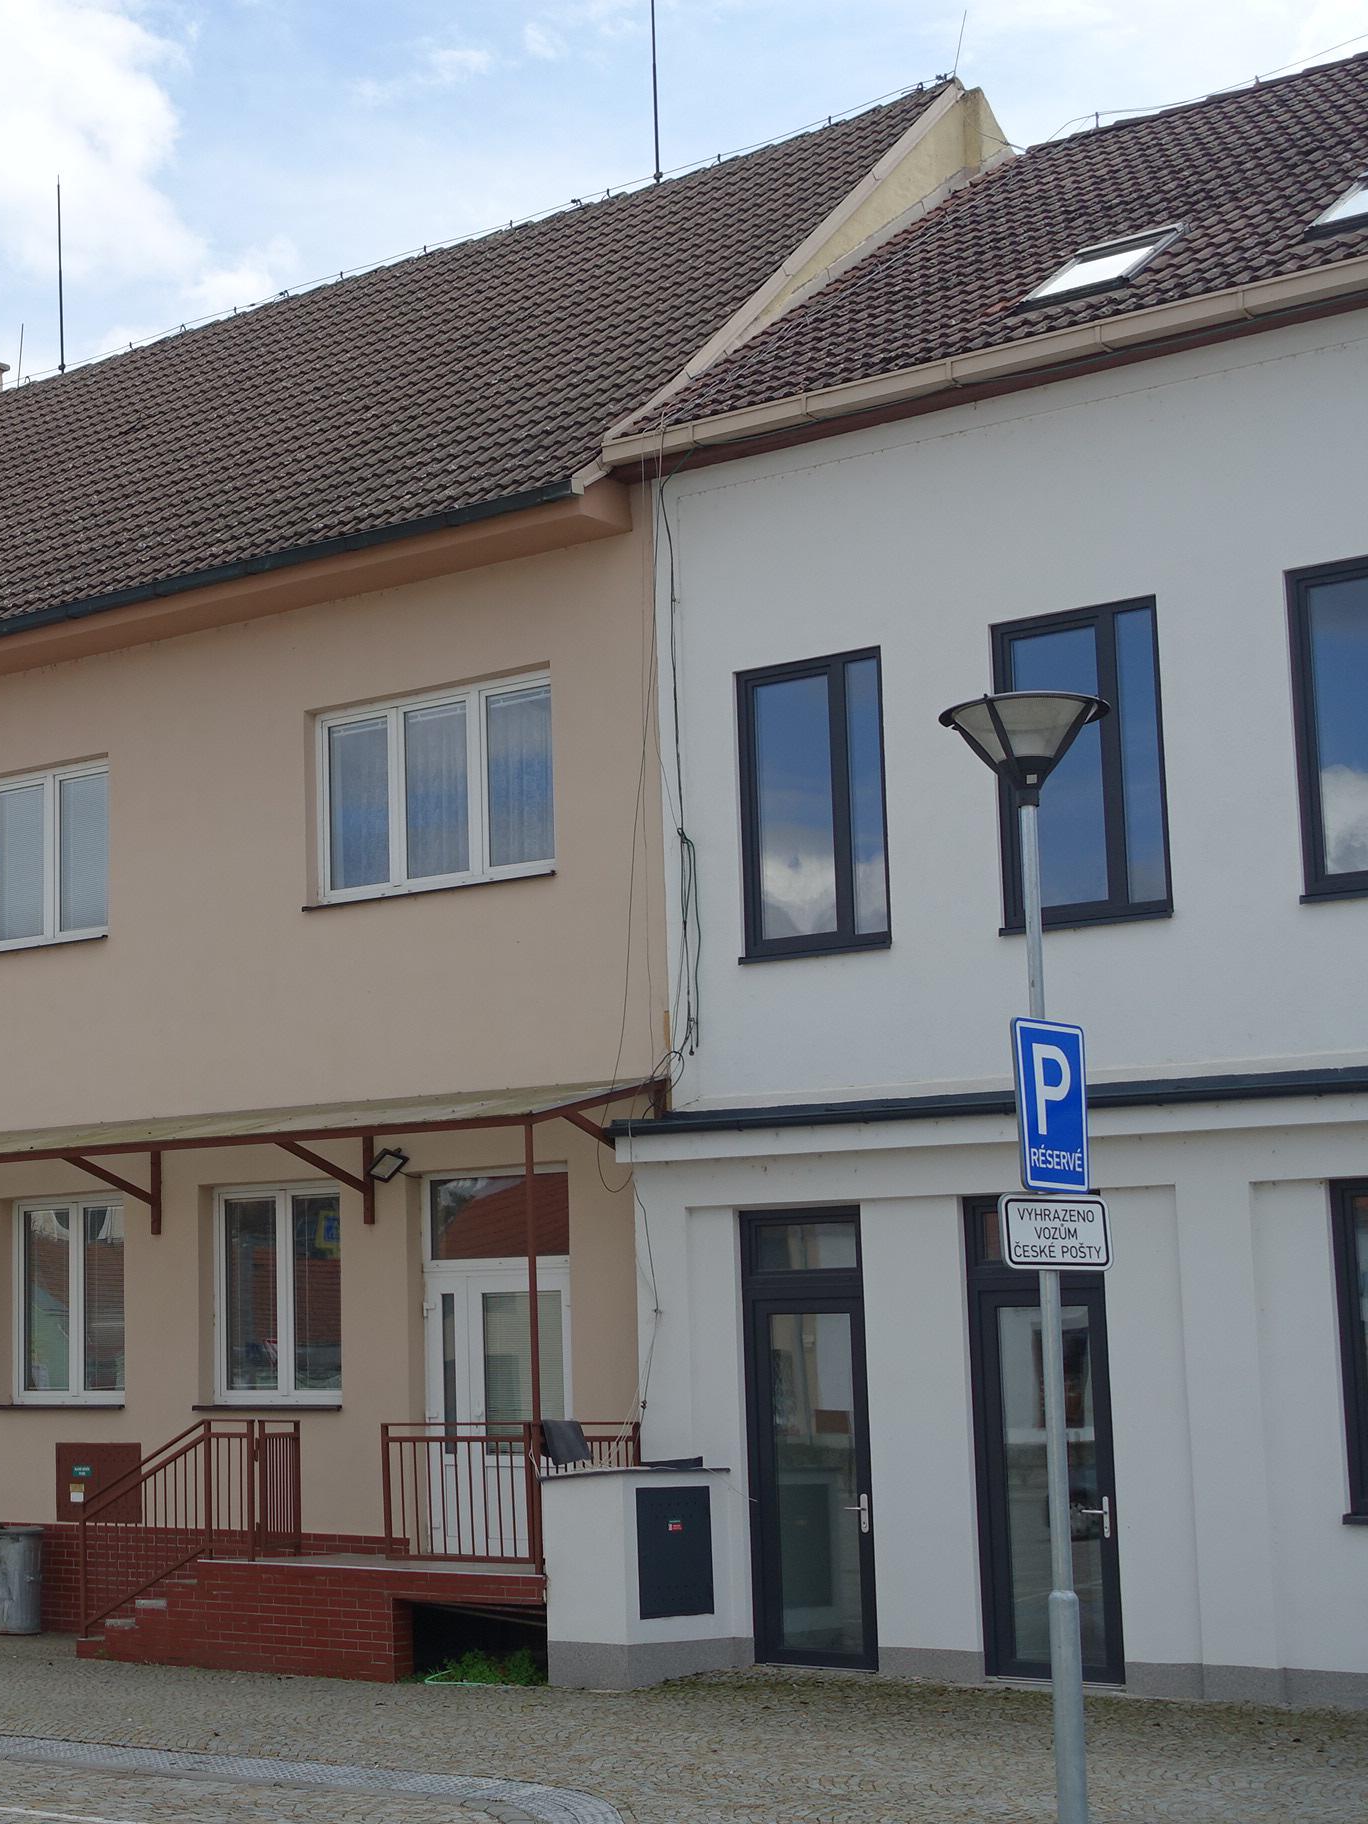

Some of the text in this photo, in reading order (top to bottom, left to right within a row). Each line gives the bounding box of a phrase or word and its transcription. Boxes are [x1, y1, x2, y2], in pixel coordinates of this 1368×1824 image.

[1032, 1042, 1071, 1135] P
[1031, 1144, 1083, 1172] RÉSERVÉ
[1017, 1208, 1095, 1223] VYHRAZENO
[1034, 1223, 1078, 1241] VOZŮM
[1013, 1241, 1102, 1260] ČESKÉ POŠTY
